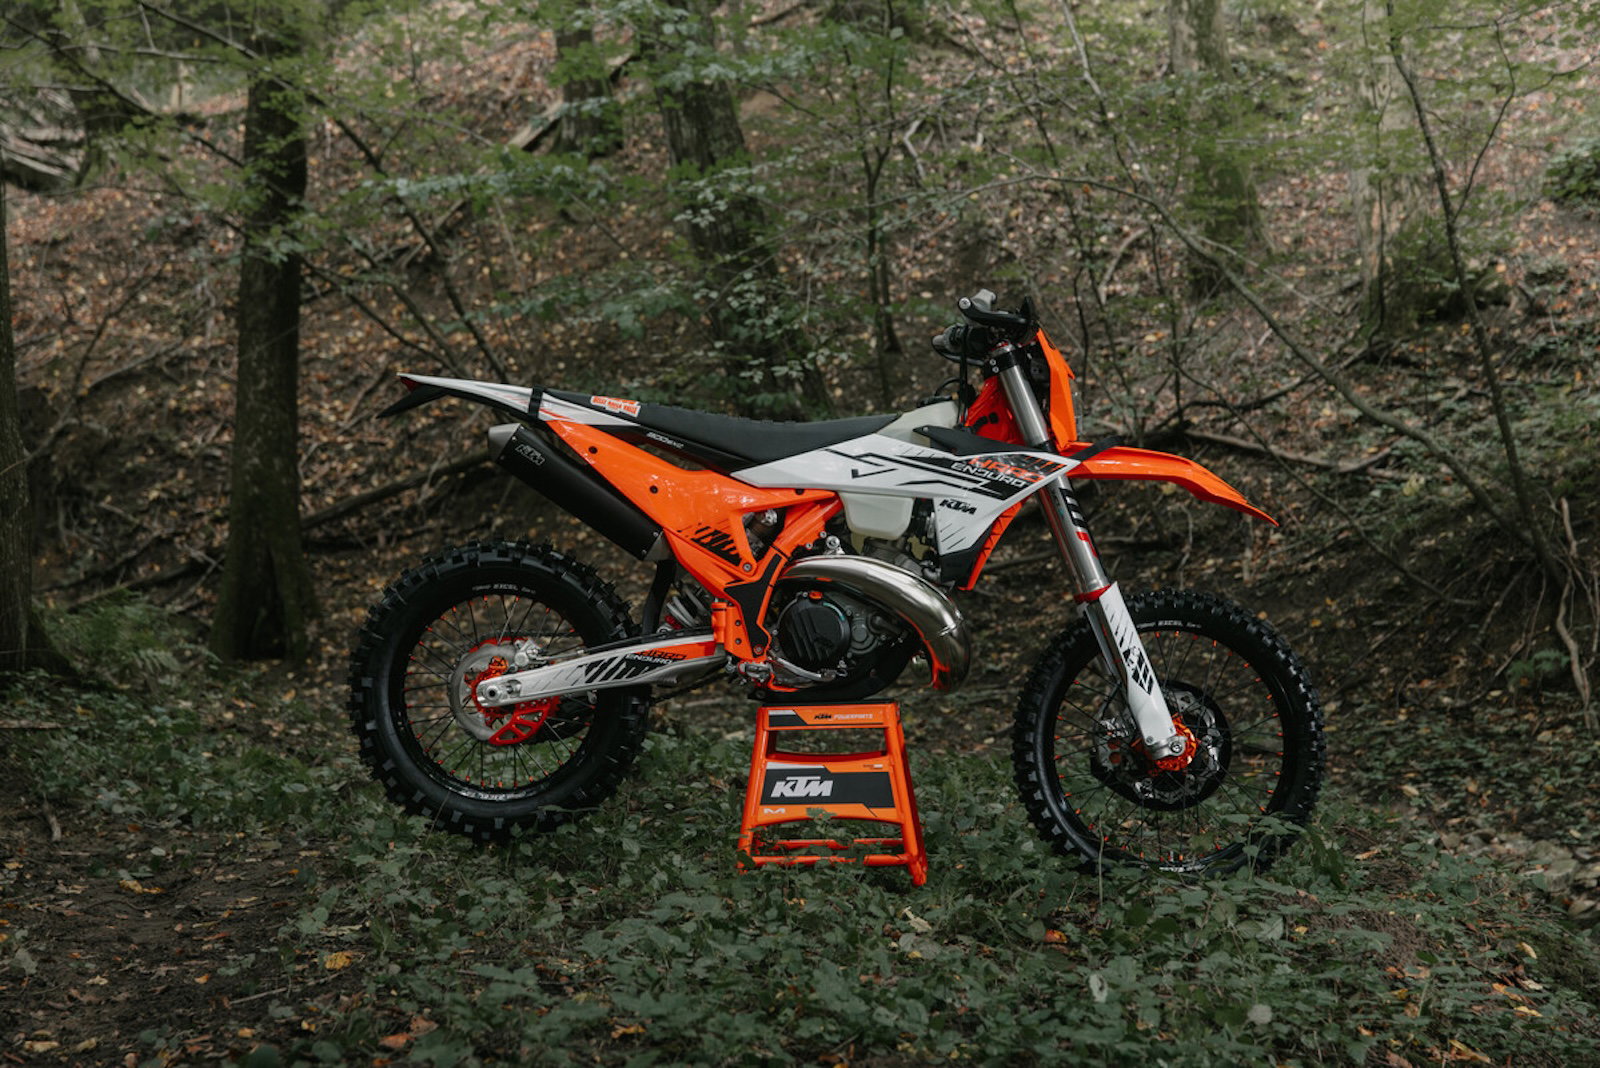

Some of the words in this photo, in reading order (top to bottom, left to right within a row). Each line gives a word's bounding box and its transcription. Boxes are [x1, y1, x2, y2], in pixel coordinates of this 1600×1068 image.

[950, 461, 1028, 488] ENDURO
[939, 499, 977, 515] KTM
[625, 653, 673, 665] ENDURO
[770, 775, 834, 798] KTM
